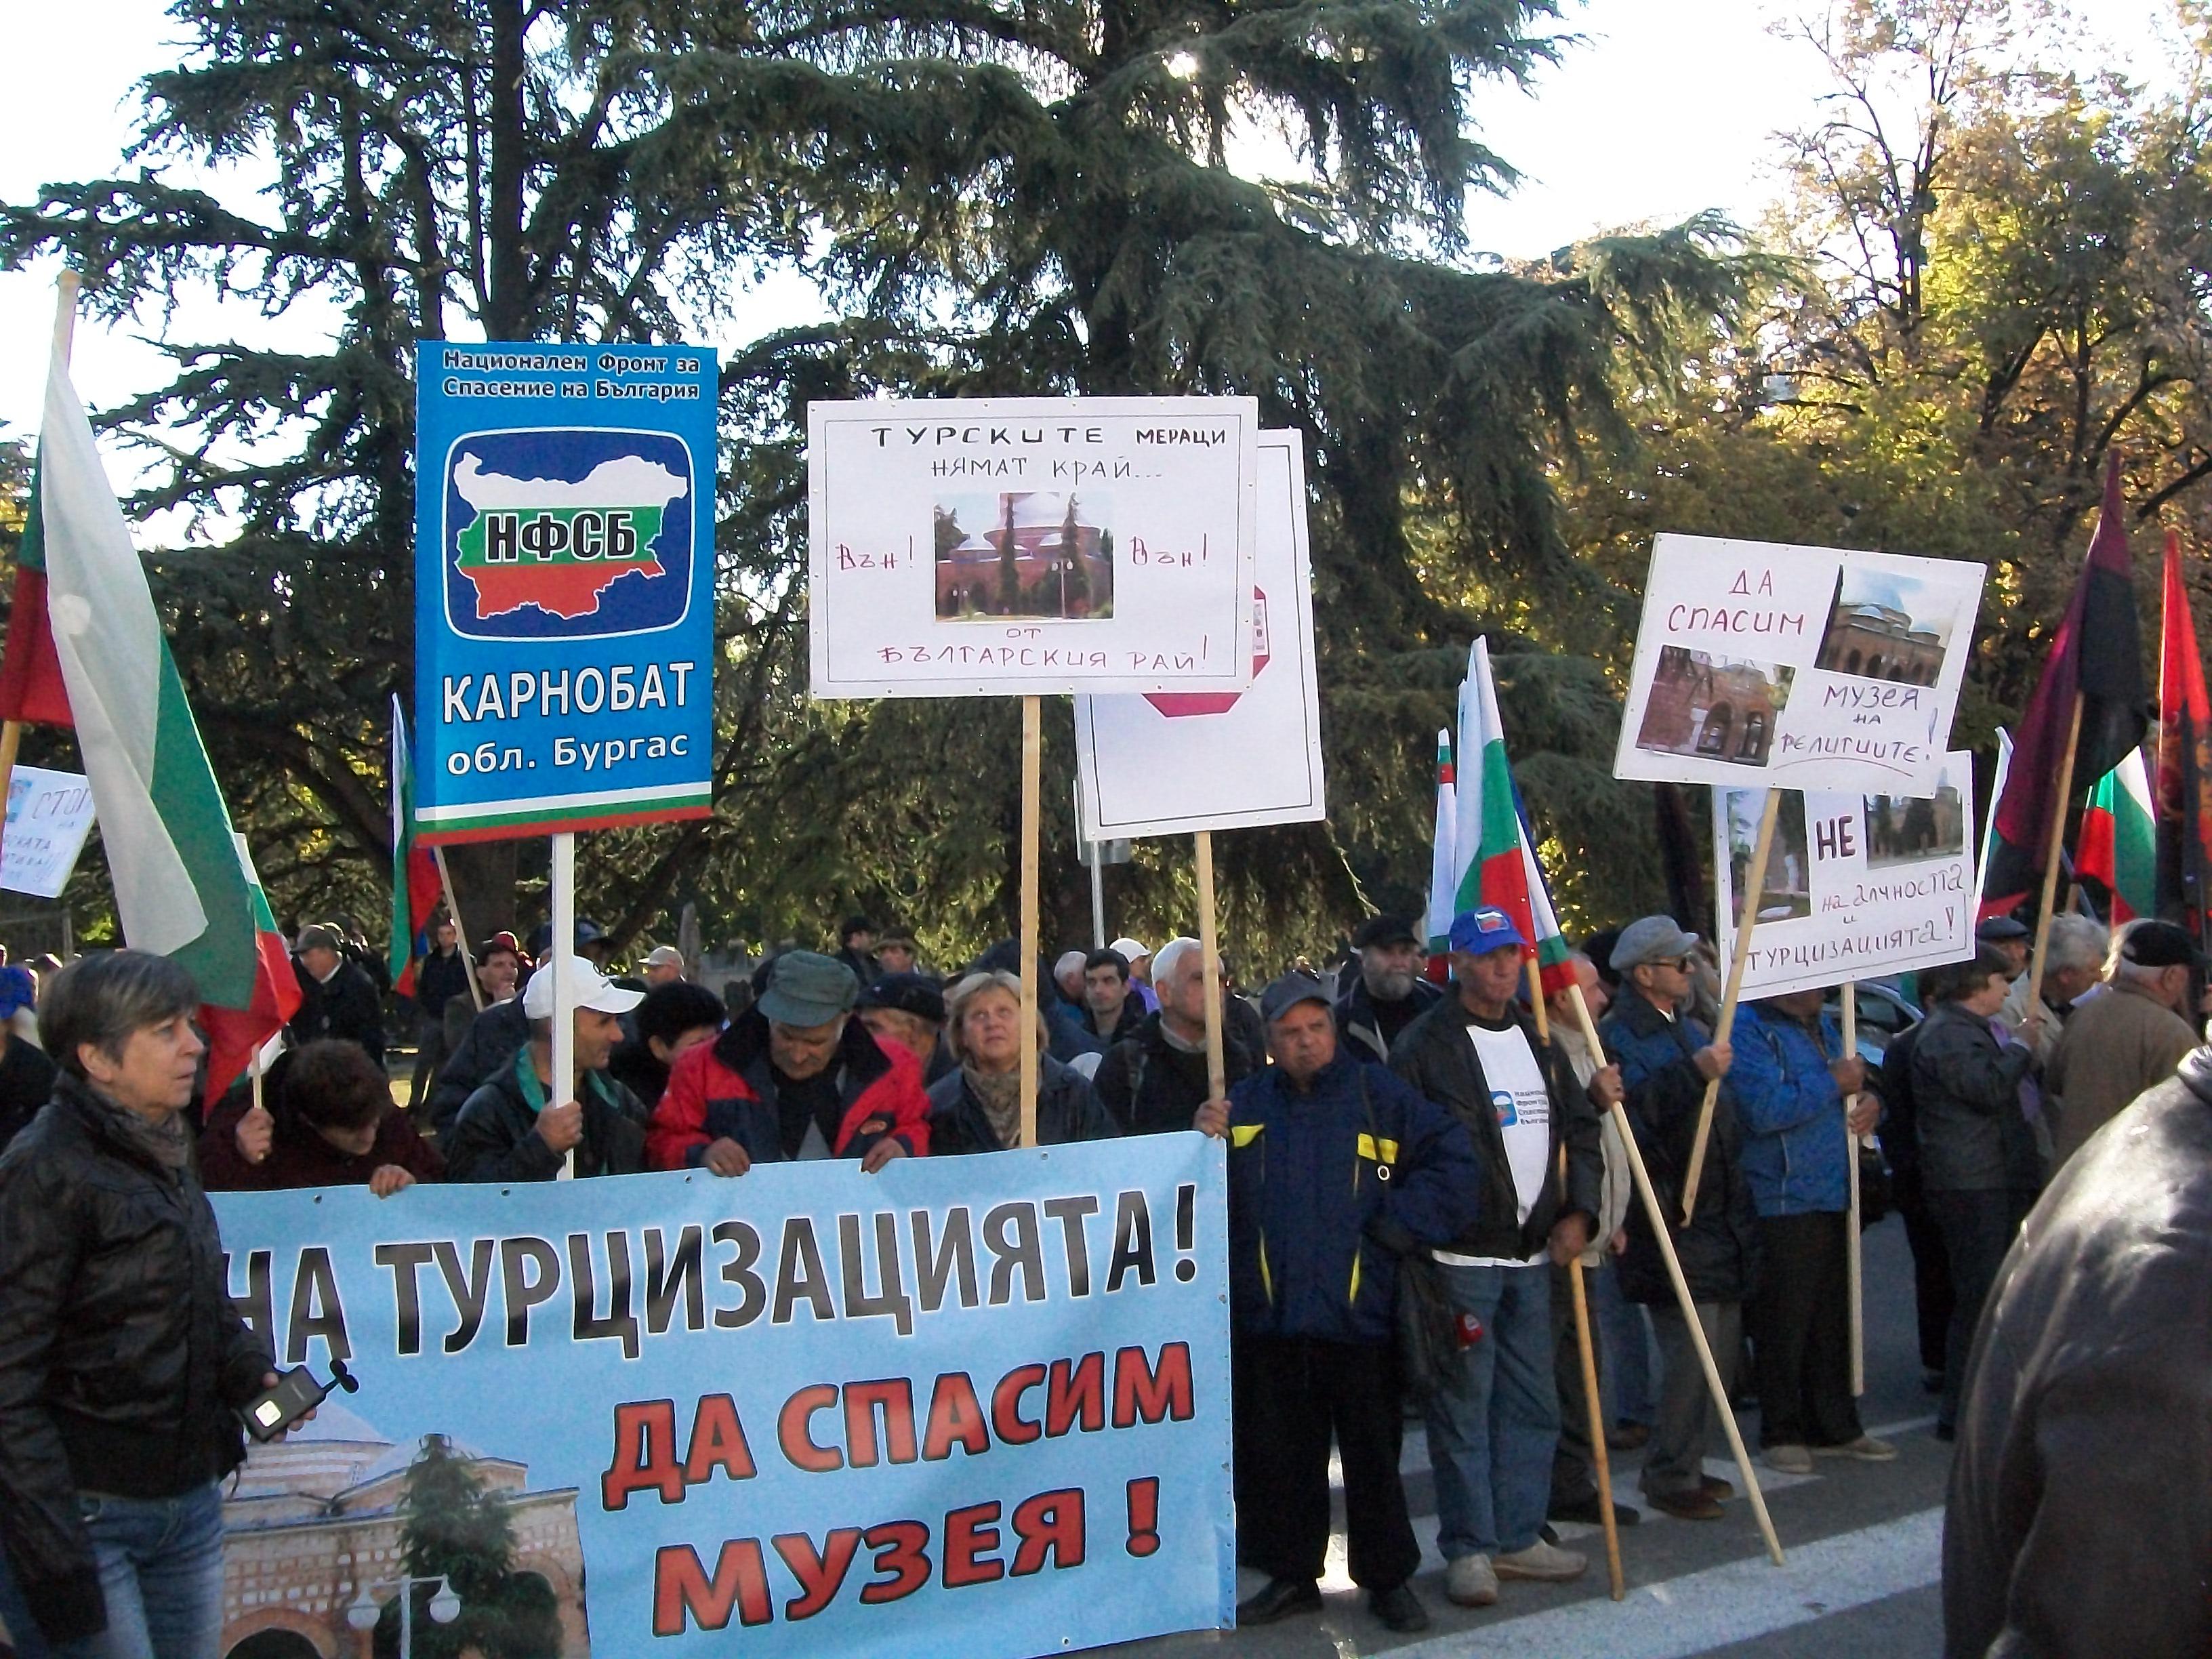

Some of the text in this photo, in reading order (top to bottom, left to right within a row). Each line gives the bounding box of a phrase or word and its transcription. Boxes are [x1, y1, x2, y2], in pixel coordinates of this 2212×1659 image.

[443, 351, 700, 375] Национален Фронт за
[443, 377, 700, 403] Спасение на България
[930, 457, 1029, 478] НЯМАТ
[485, 510, 637, 562] НФСБ
[1727, 569, 1774, 597] ДА
[1005, 627, 1042, 639] ОТ
[1668, 604, 1805, 636] СПАСИМ
[443, 661, 695, 723] КАРНОБАТ
[447, 734, 689, 775] обл. Бургас
[1816, 815, 1857, 861] НЕ
[220, 1183, 1199, 1365] НА ТУРЦИЗАЦИЯТА!
[601, 1340, 1196, 1511] ДА СПАСИМ
[651, 1486, 1086, 1639] МУЗЕЯ
